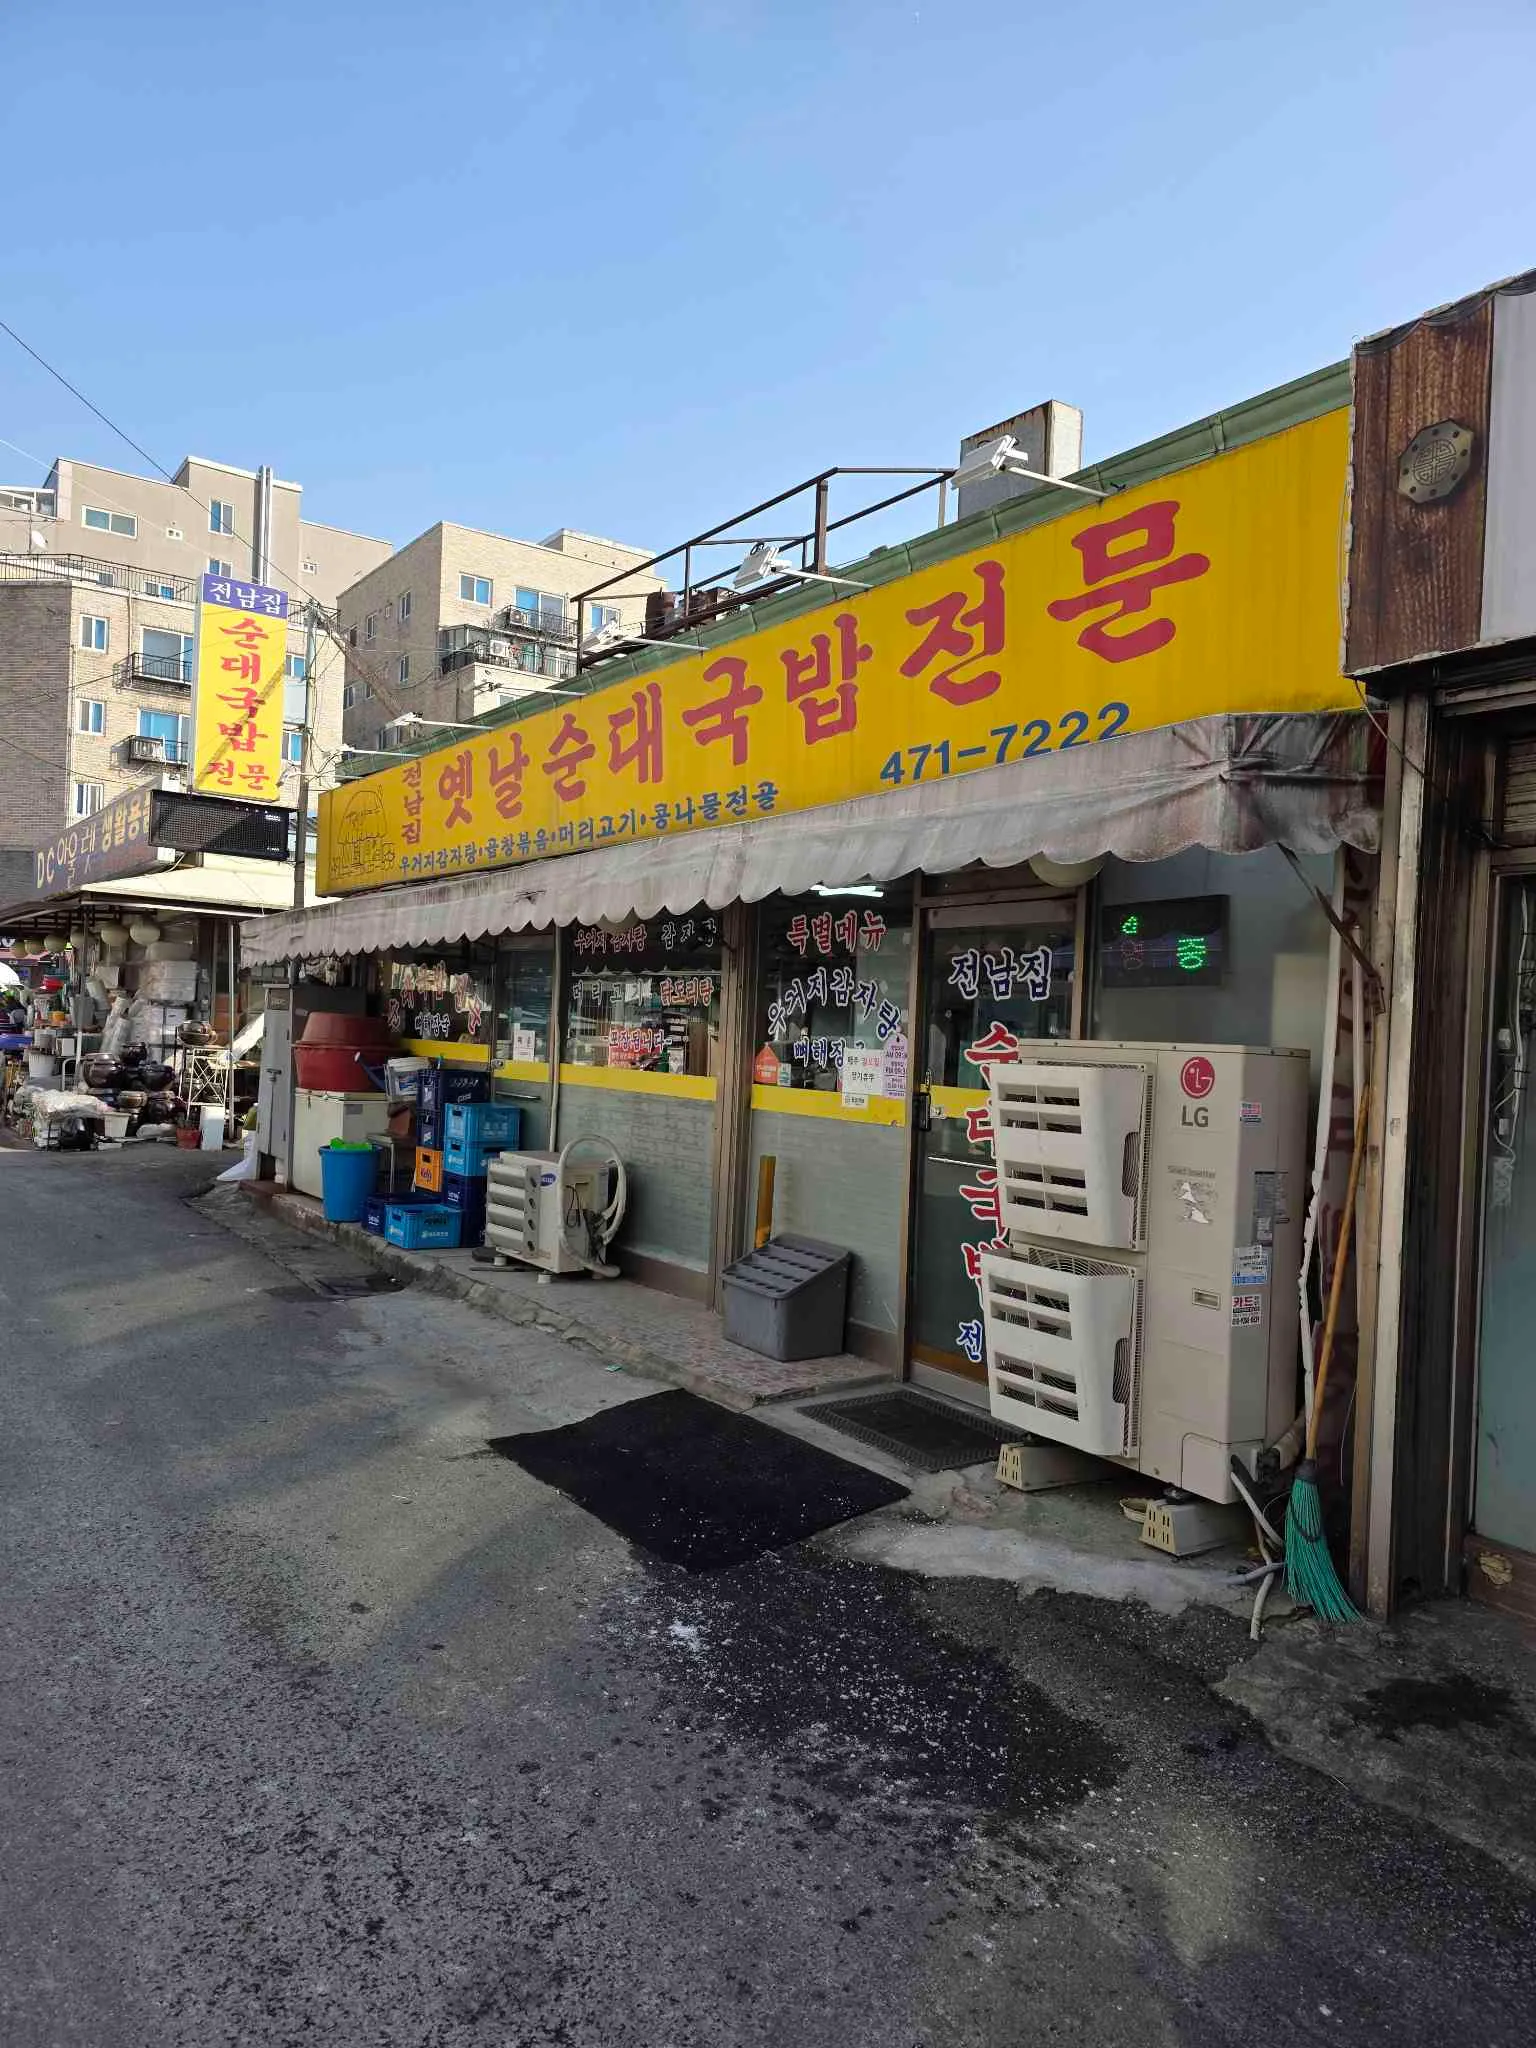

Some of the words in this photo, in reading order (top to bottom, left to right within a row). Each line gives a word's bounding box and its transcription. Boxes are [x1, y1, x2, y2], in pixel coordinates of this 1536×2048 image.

[208, 581, 281, 615] 전남집
[215, 617, 269, 753] 순대국밥
[880, 702, 1131, 784] 471-7222
[210, 758, 270, 791] 전문
[401, 761, 424, 846] 전남집
[786, 909, 887, 955] 특별메뉴
[947, 944, 1053, 1001] 전남집
[766, 966, 900, 1041] 우거지감자탕
[1181, 1105, 1209, 1128] LG
